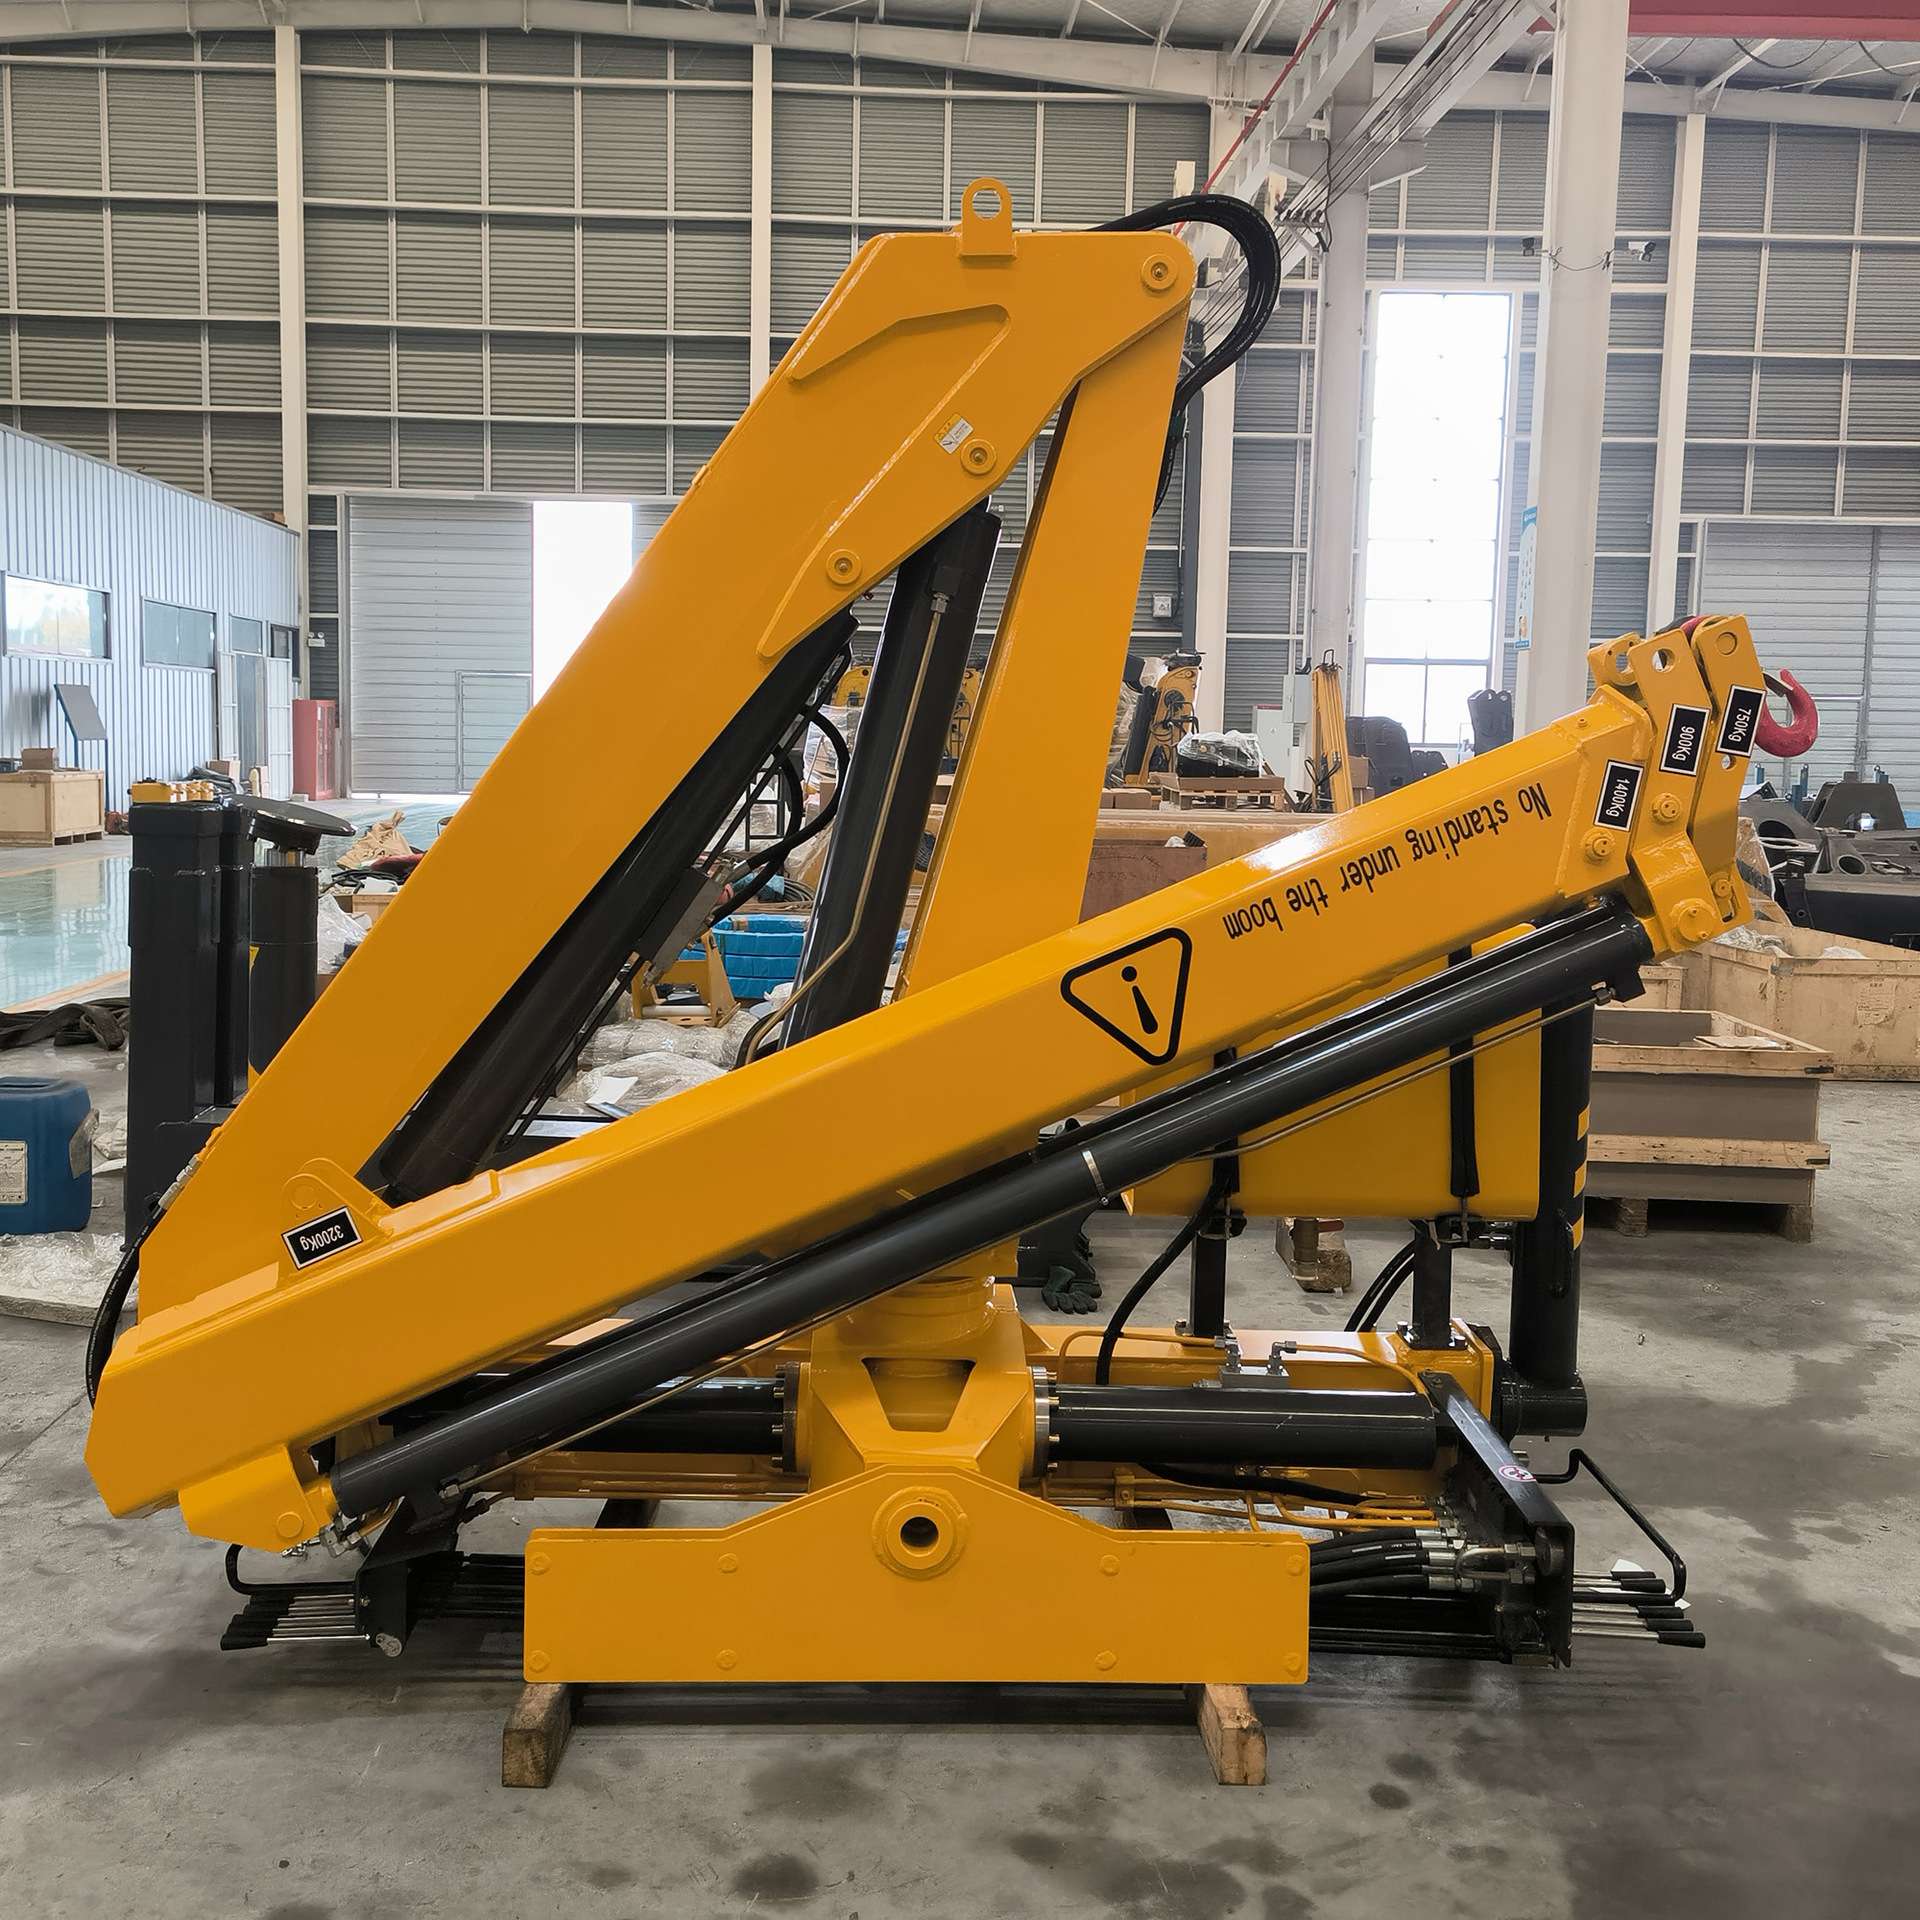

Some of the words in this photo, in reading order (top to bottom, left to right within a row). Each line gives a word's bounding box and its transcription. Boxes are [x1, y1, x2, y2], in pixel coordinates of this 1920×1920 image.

[1672, 726, 1695, 761] 900Kg
[1728, 708, 1752, 742] 750Kg
[1518, 782, 1552, 821] No
[1606, 778, 1631, 817] 1400Kg
[1405, 799, 1509, 862] standing
[1340, 845, 1401, 893] under
[1286, 878, 1329, 916] the
[1223, 897, 1283, 940] boom
[300, 1225, 344, 1252] 3200Kg
